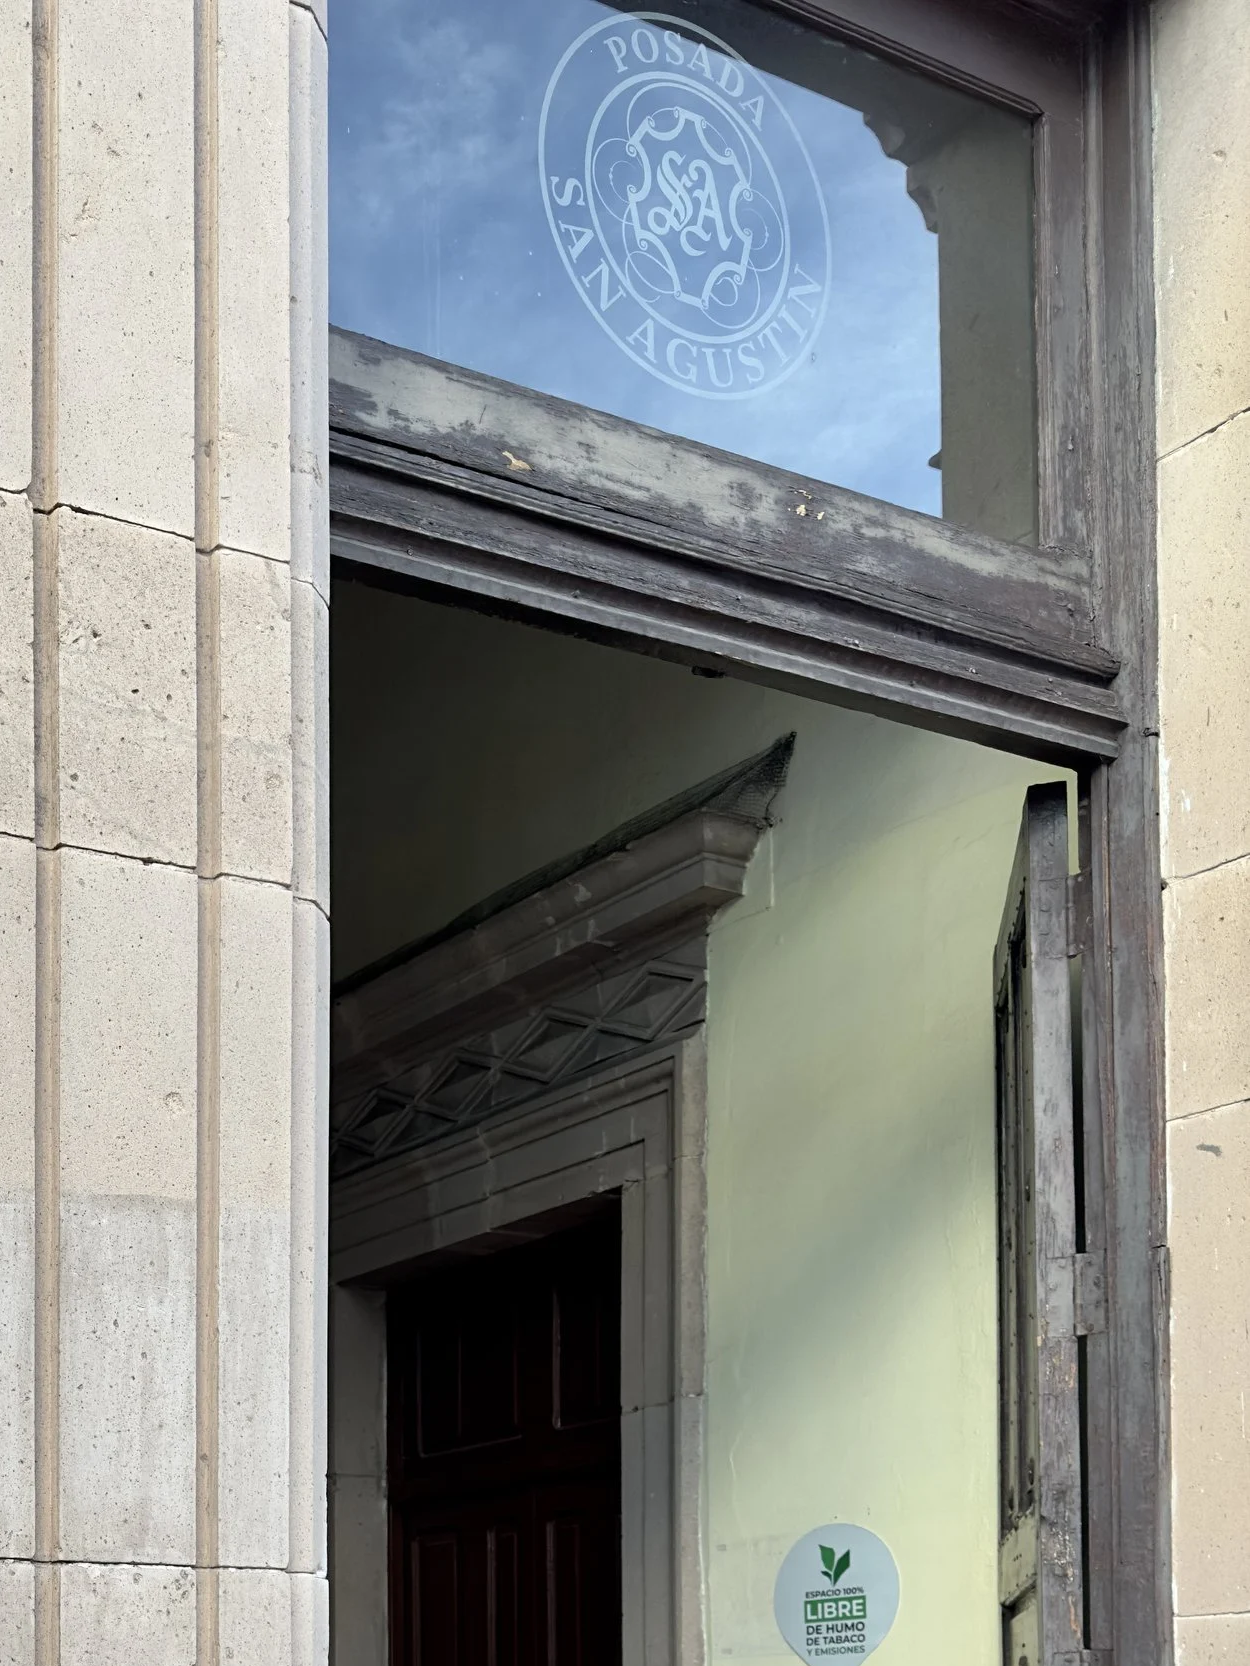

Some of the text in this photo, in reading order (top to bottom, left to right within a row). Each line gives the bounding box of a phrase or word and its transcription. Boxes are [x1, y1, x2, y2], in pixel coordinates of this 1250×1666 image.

[604, 28, 766, 131] POSADA
[550, 175, 823, 388] SAN AGUSTIN
[805, 1587, 864, 1599] ESPACIO 100%
[806, 1599, 864, 1620] LIBRE
[806, 1621, 865, 1635] DE HUMO
[806, 1634, 866, 1646] DE TABACO
[806, 1645, 865, 1656] Y EMISIONES
